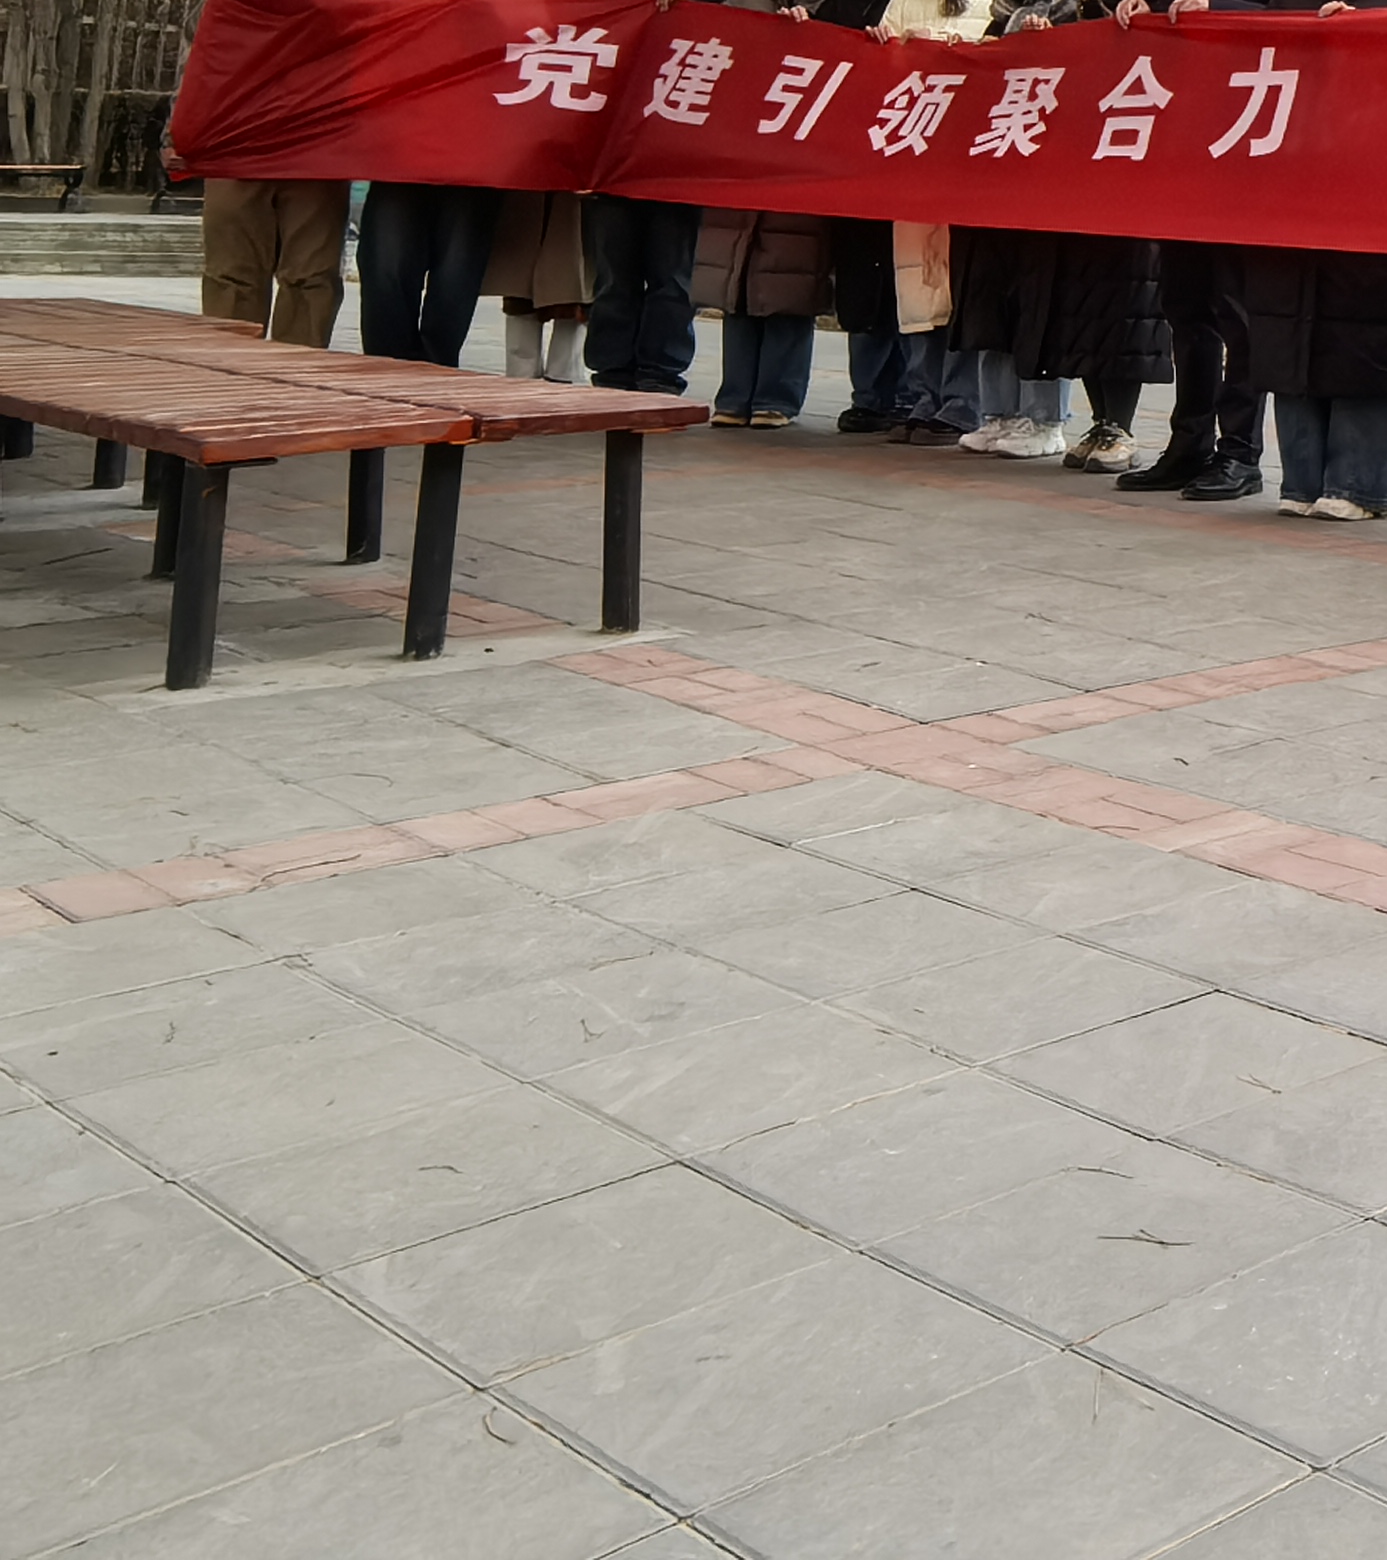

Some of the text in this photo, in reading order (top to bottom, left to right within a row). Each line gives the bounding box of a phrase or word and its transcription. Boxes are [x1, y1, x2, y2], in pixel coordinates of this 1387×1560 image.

[493, 24, 1299, 162] 党建引领聚合力
